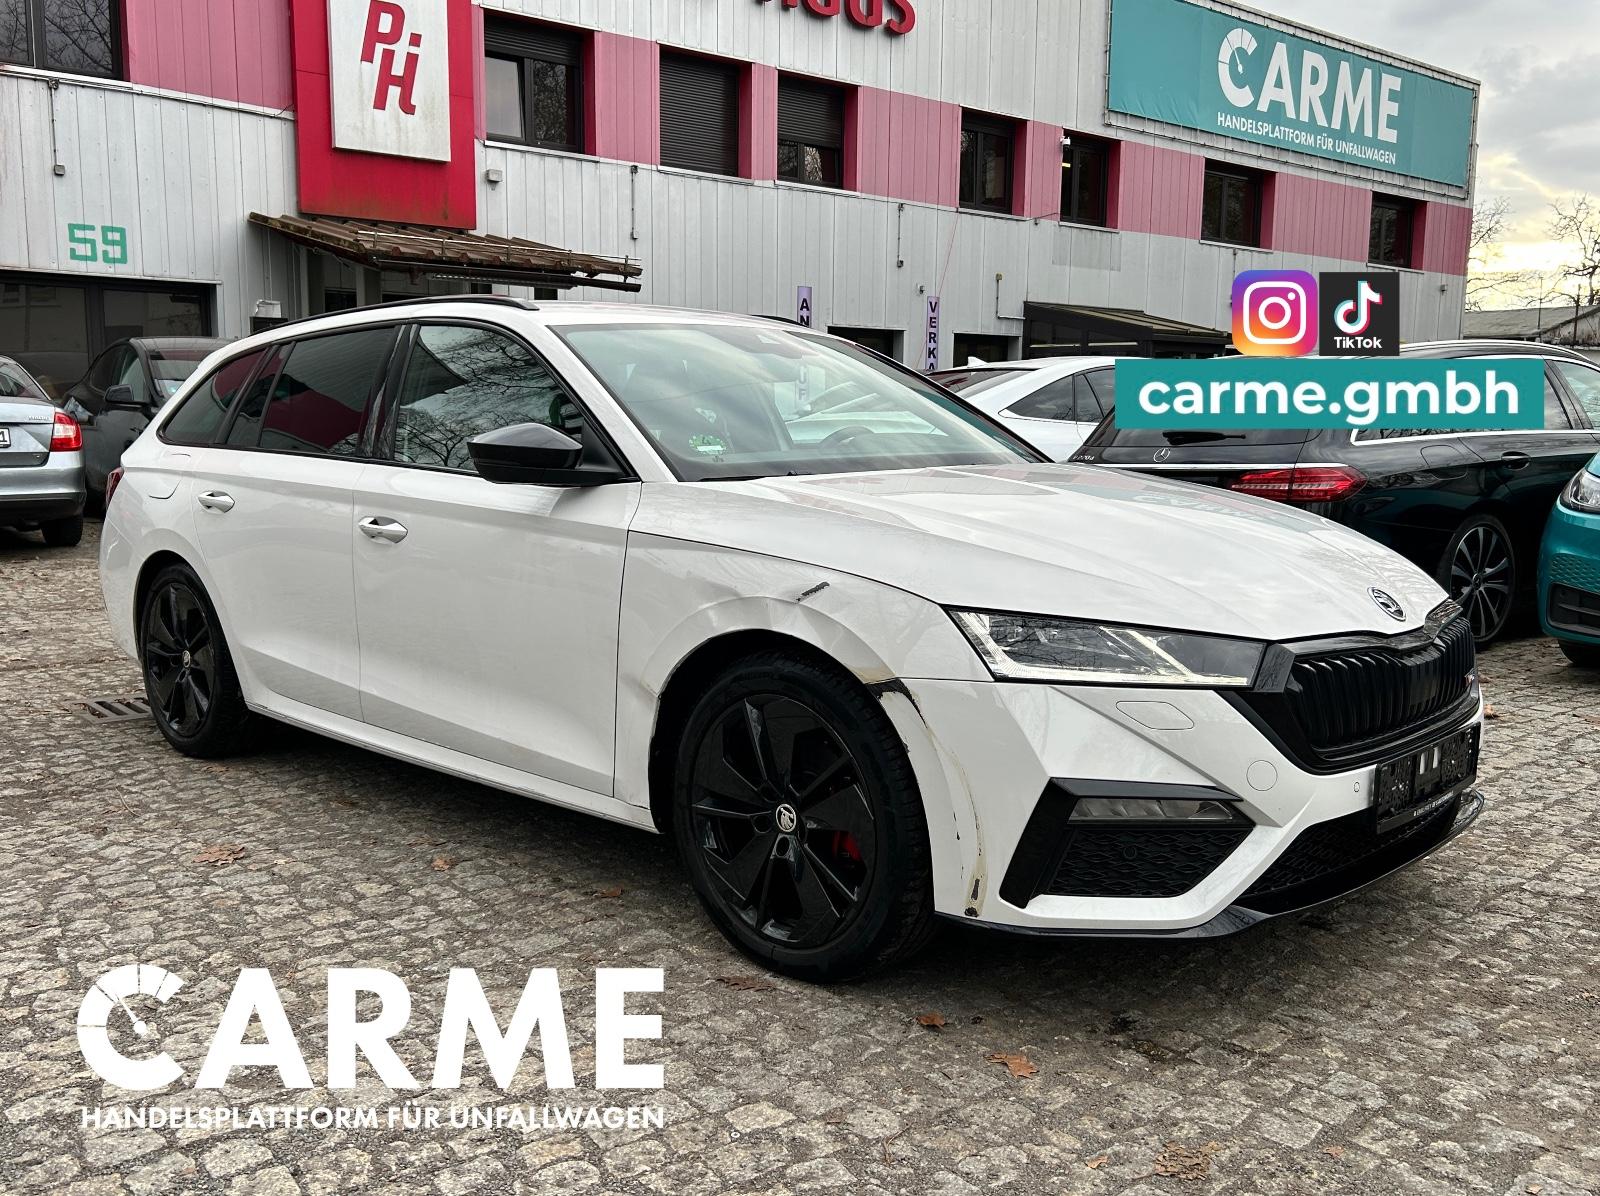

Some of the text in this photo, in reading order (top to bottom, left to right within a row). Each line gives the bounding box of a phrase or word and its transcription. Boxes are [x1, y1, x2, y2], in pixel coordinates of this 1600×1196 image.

[1218, 28, 1402, 144] CARME
[1217, 111, 1396, 165] HANDELSPLATTFORM FÜR UNFALLWAGEN
[68, 223, 128, 264] 59
